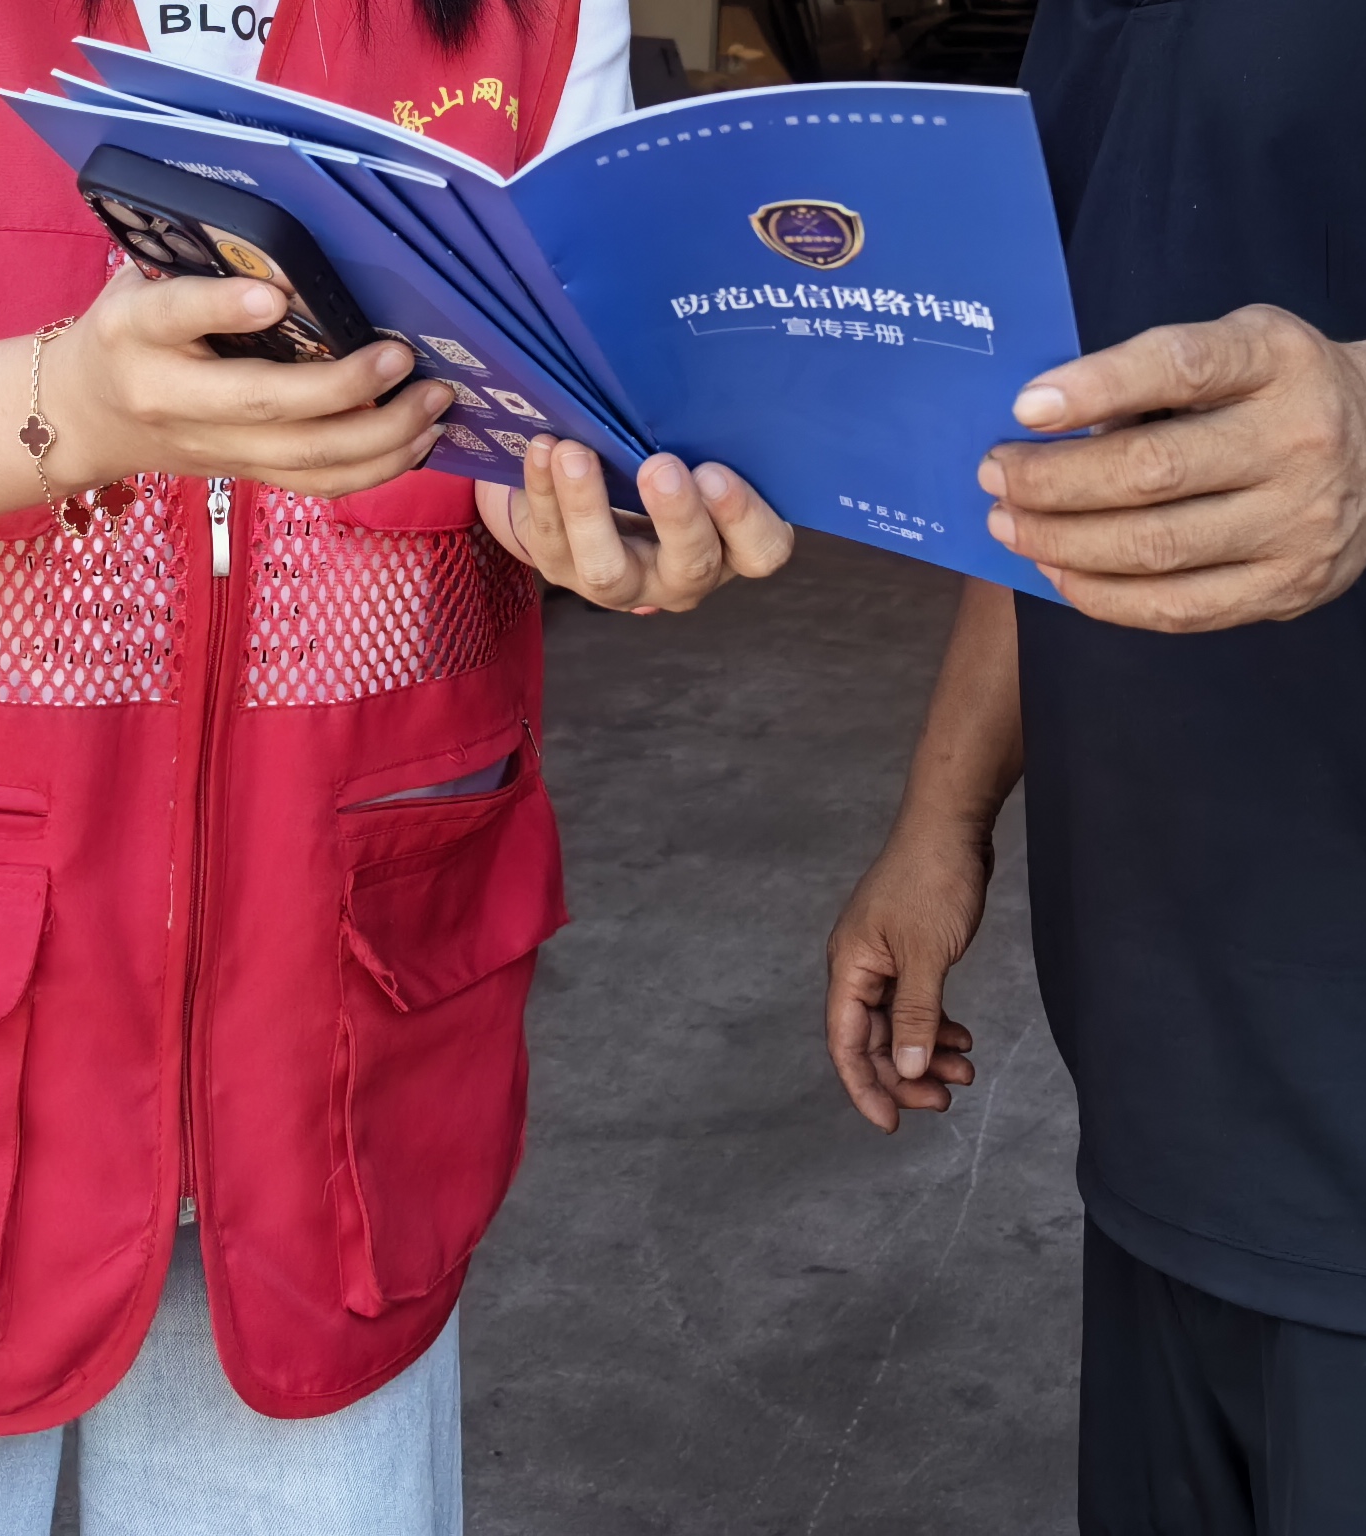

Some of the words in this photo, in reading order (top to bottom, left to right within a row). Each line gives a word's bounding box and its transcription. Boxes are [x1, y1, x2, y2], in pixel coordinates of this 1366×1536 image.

[670, 284, 995, 332] 防范电信网络诈骗
[781, 317, 905, 346] 宣传手册
[839, 495, 945, 533] 国家反诈中心
